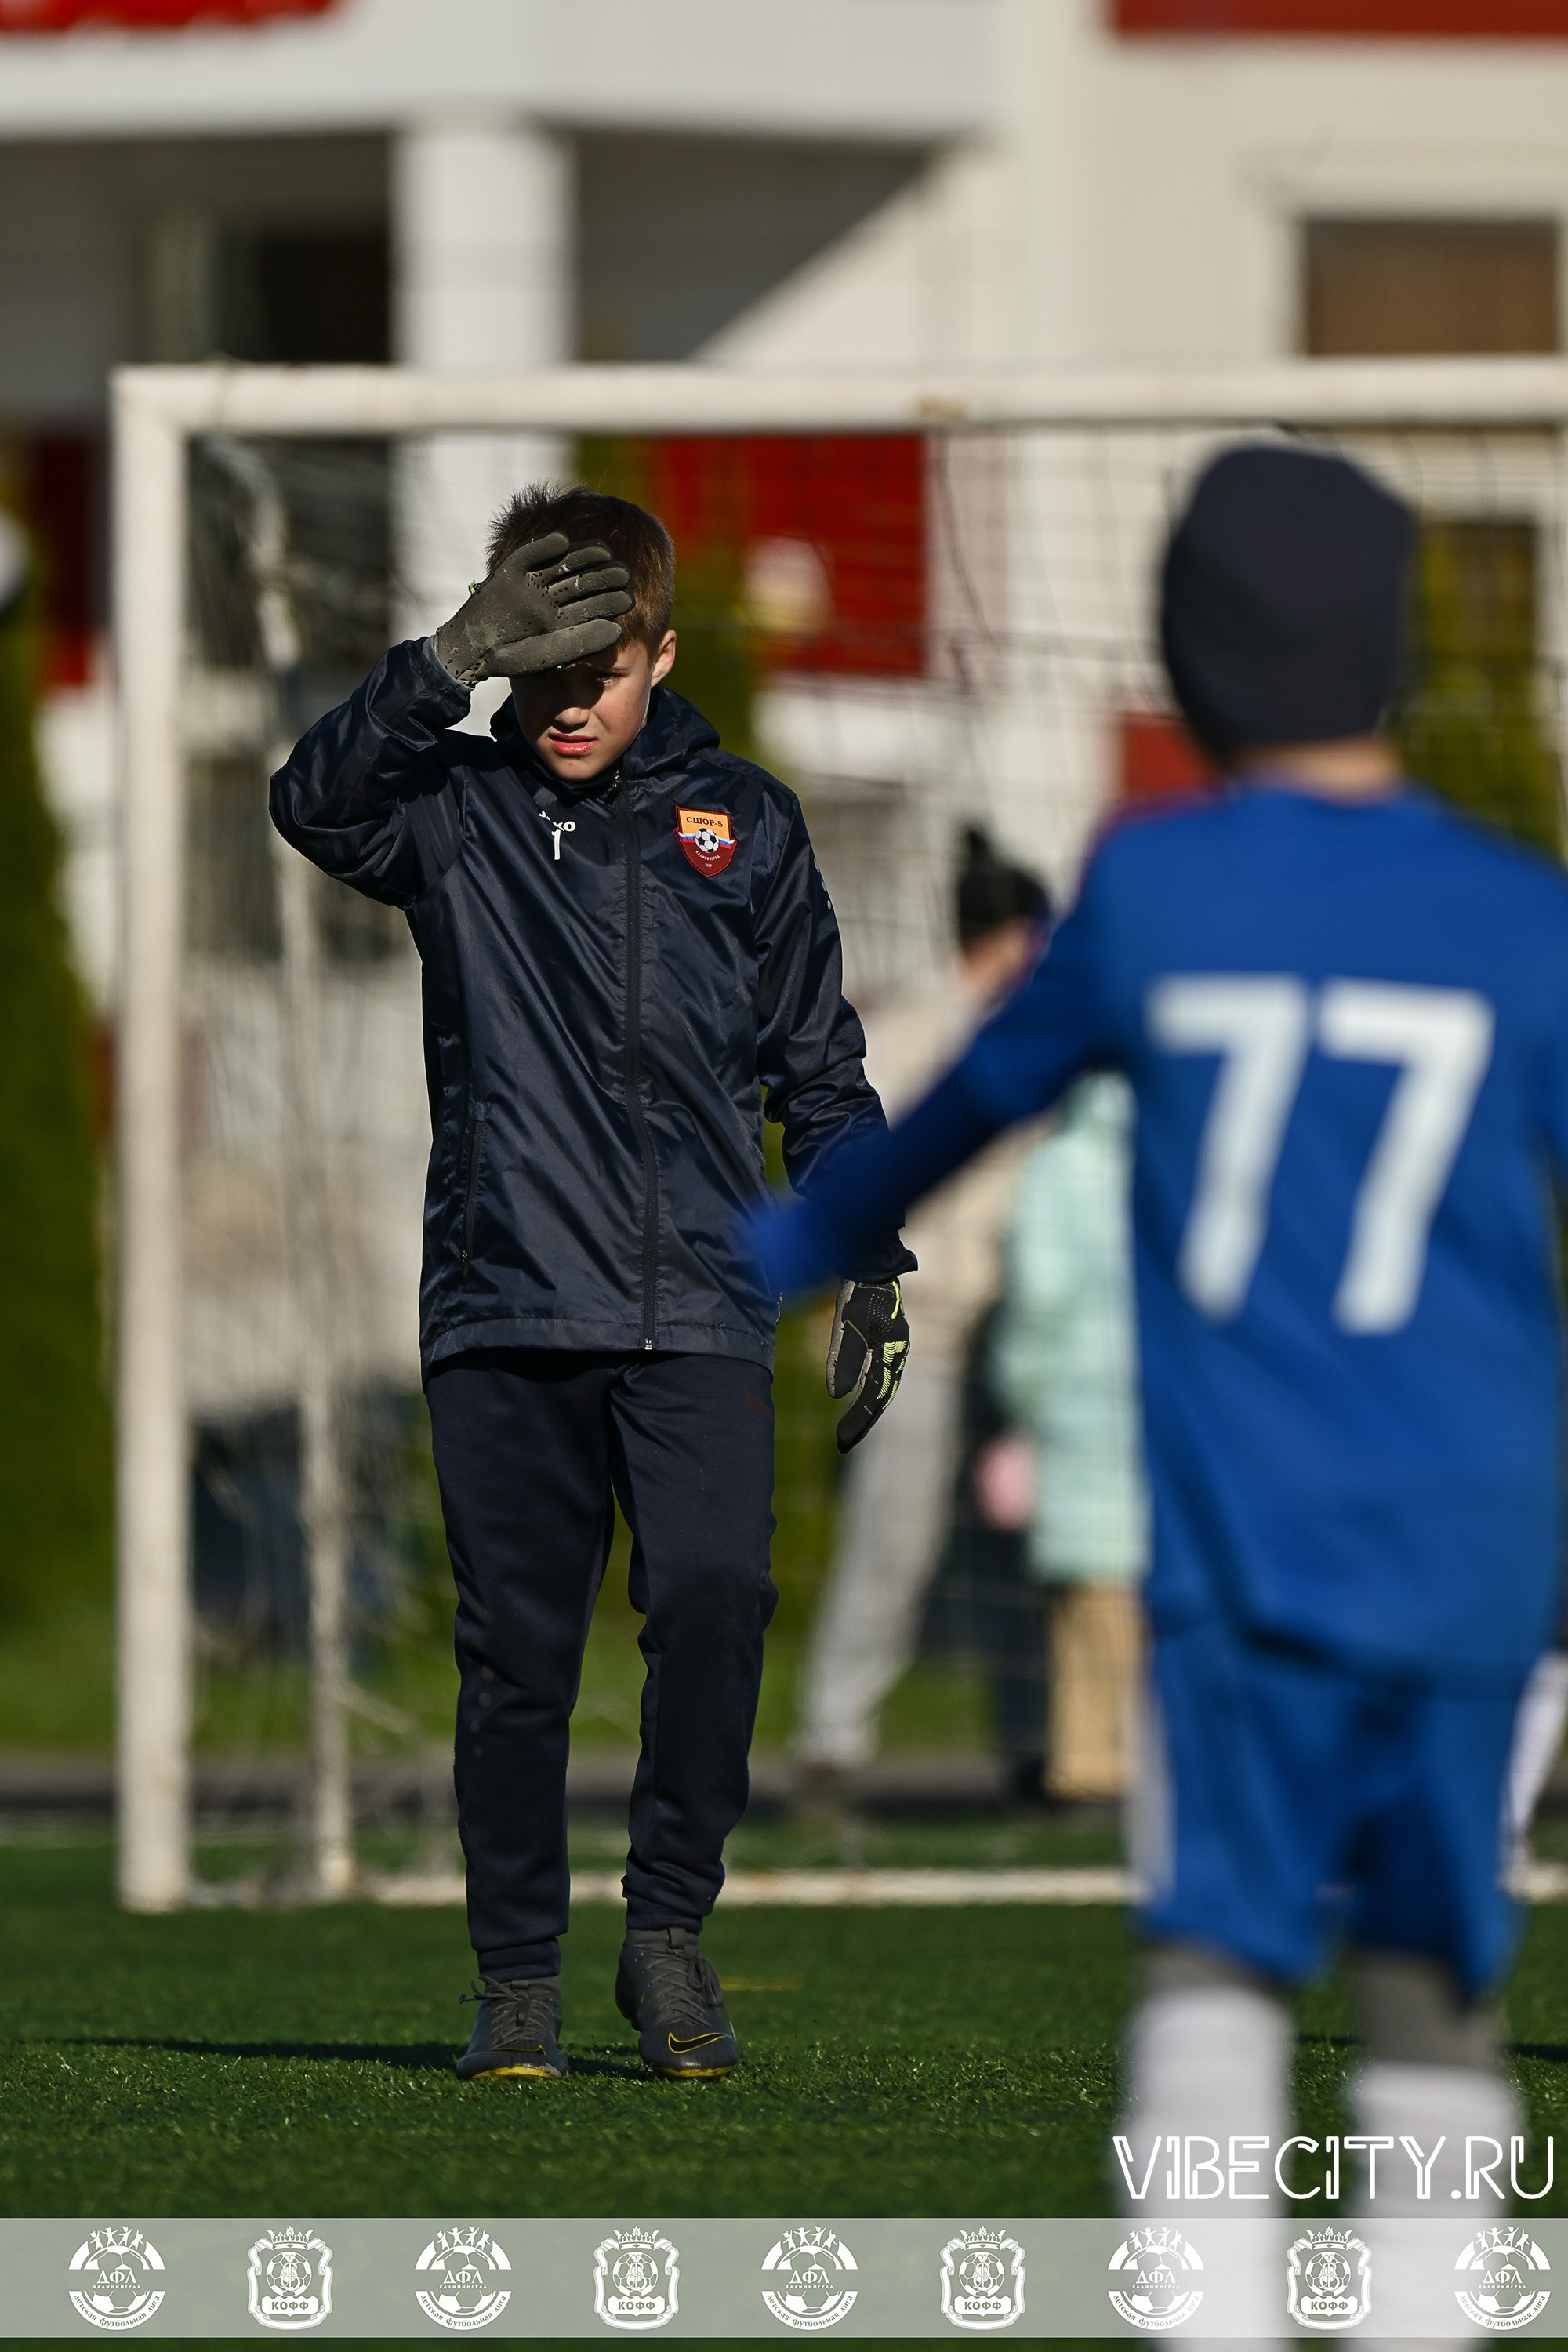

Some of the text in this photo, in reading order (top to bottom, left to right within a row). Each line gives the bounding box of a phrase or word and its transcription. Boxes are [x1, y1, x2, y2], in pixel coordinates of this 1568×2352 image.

[686, 816, 723, 827] СШОР-5
[551, 829, 561, 860] 1
[1146, 972, 1495, 1338] 77
